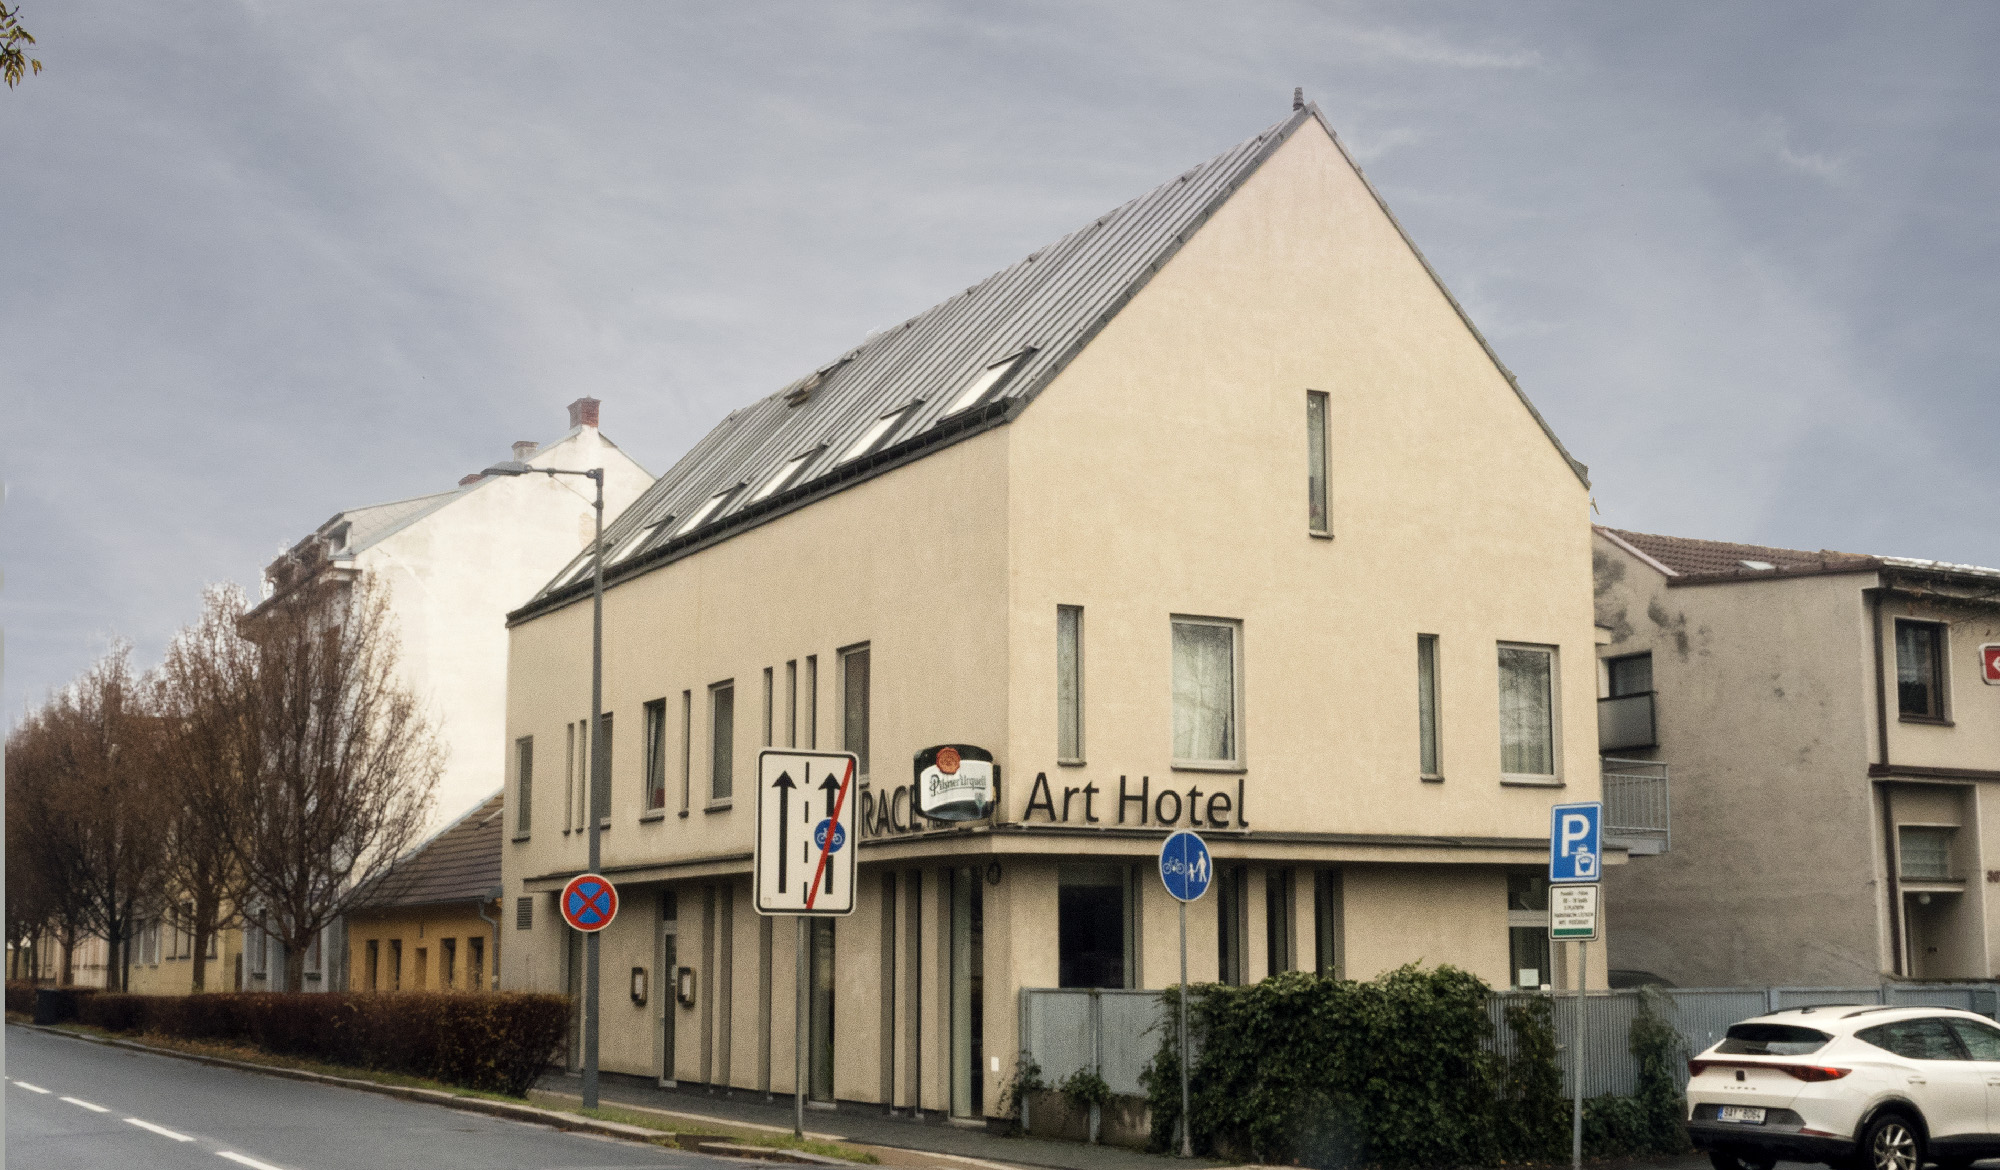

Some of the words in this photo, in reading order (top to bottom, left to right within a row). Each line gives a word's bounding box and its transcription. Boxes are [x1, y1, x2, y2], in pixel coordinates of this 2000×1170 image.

[1023, 772, 1100, 822] Art
[1118, 775, 1249, 828] Hotel
[1561, 814, 1590, 857] P
